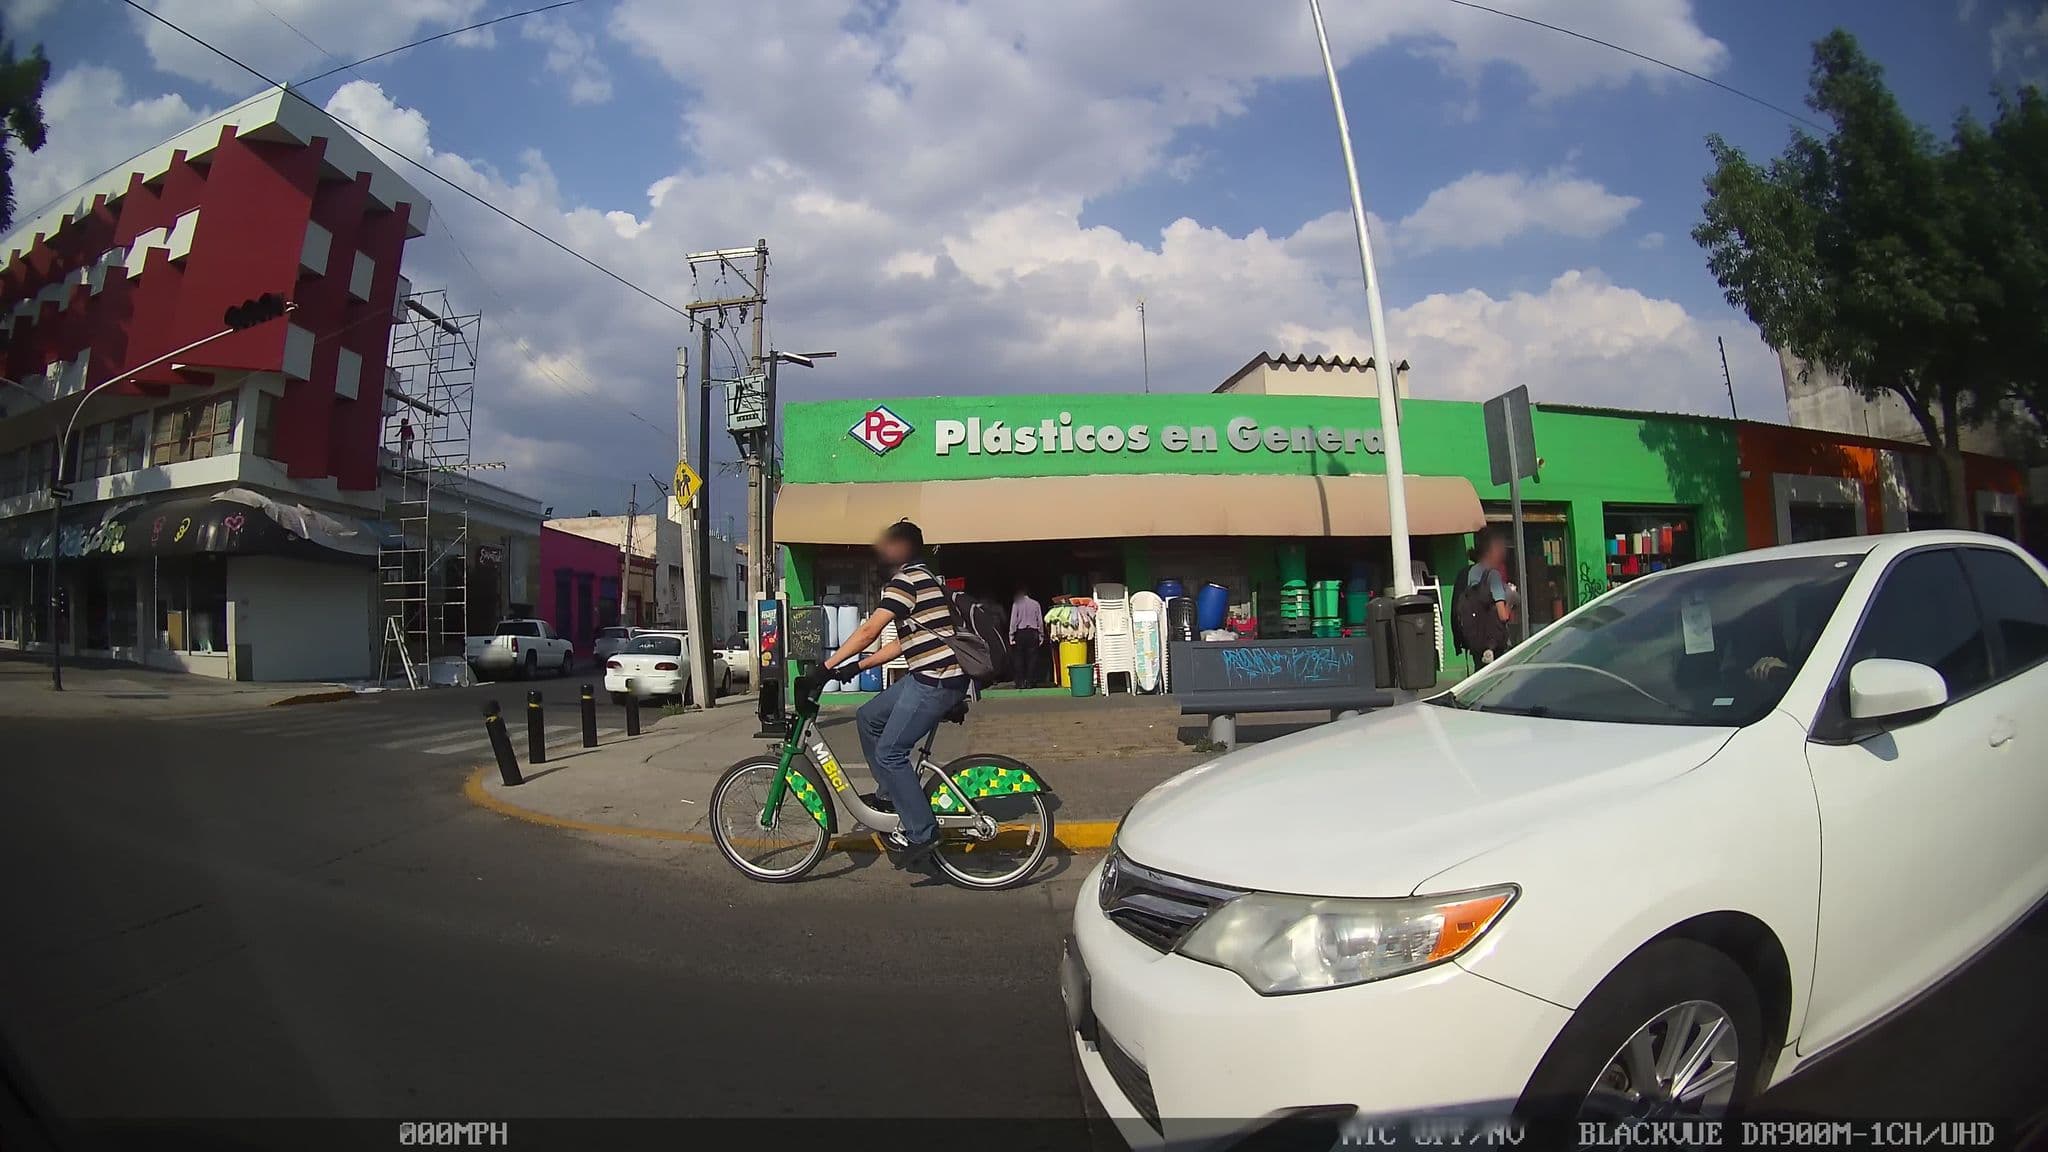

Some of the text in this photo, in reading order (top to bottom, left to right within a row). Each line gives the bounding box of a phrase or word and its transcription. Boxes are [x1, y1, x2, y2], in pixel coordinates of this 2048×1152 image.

[865, 411, 904, 448] PG
[935, 411, 1385, 455] Plásticos en Genera
[812, 742, 849, 792] MiBici
